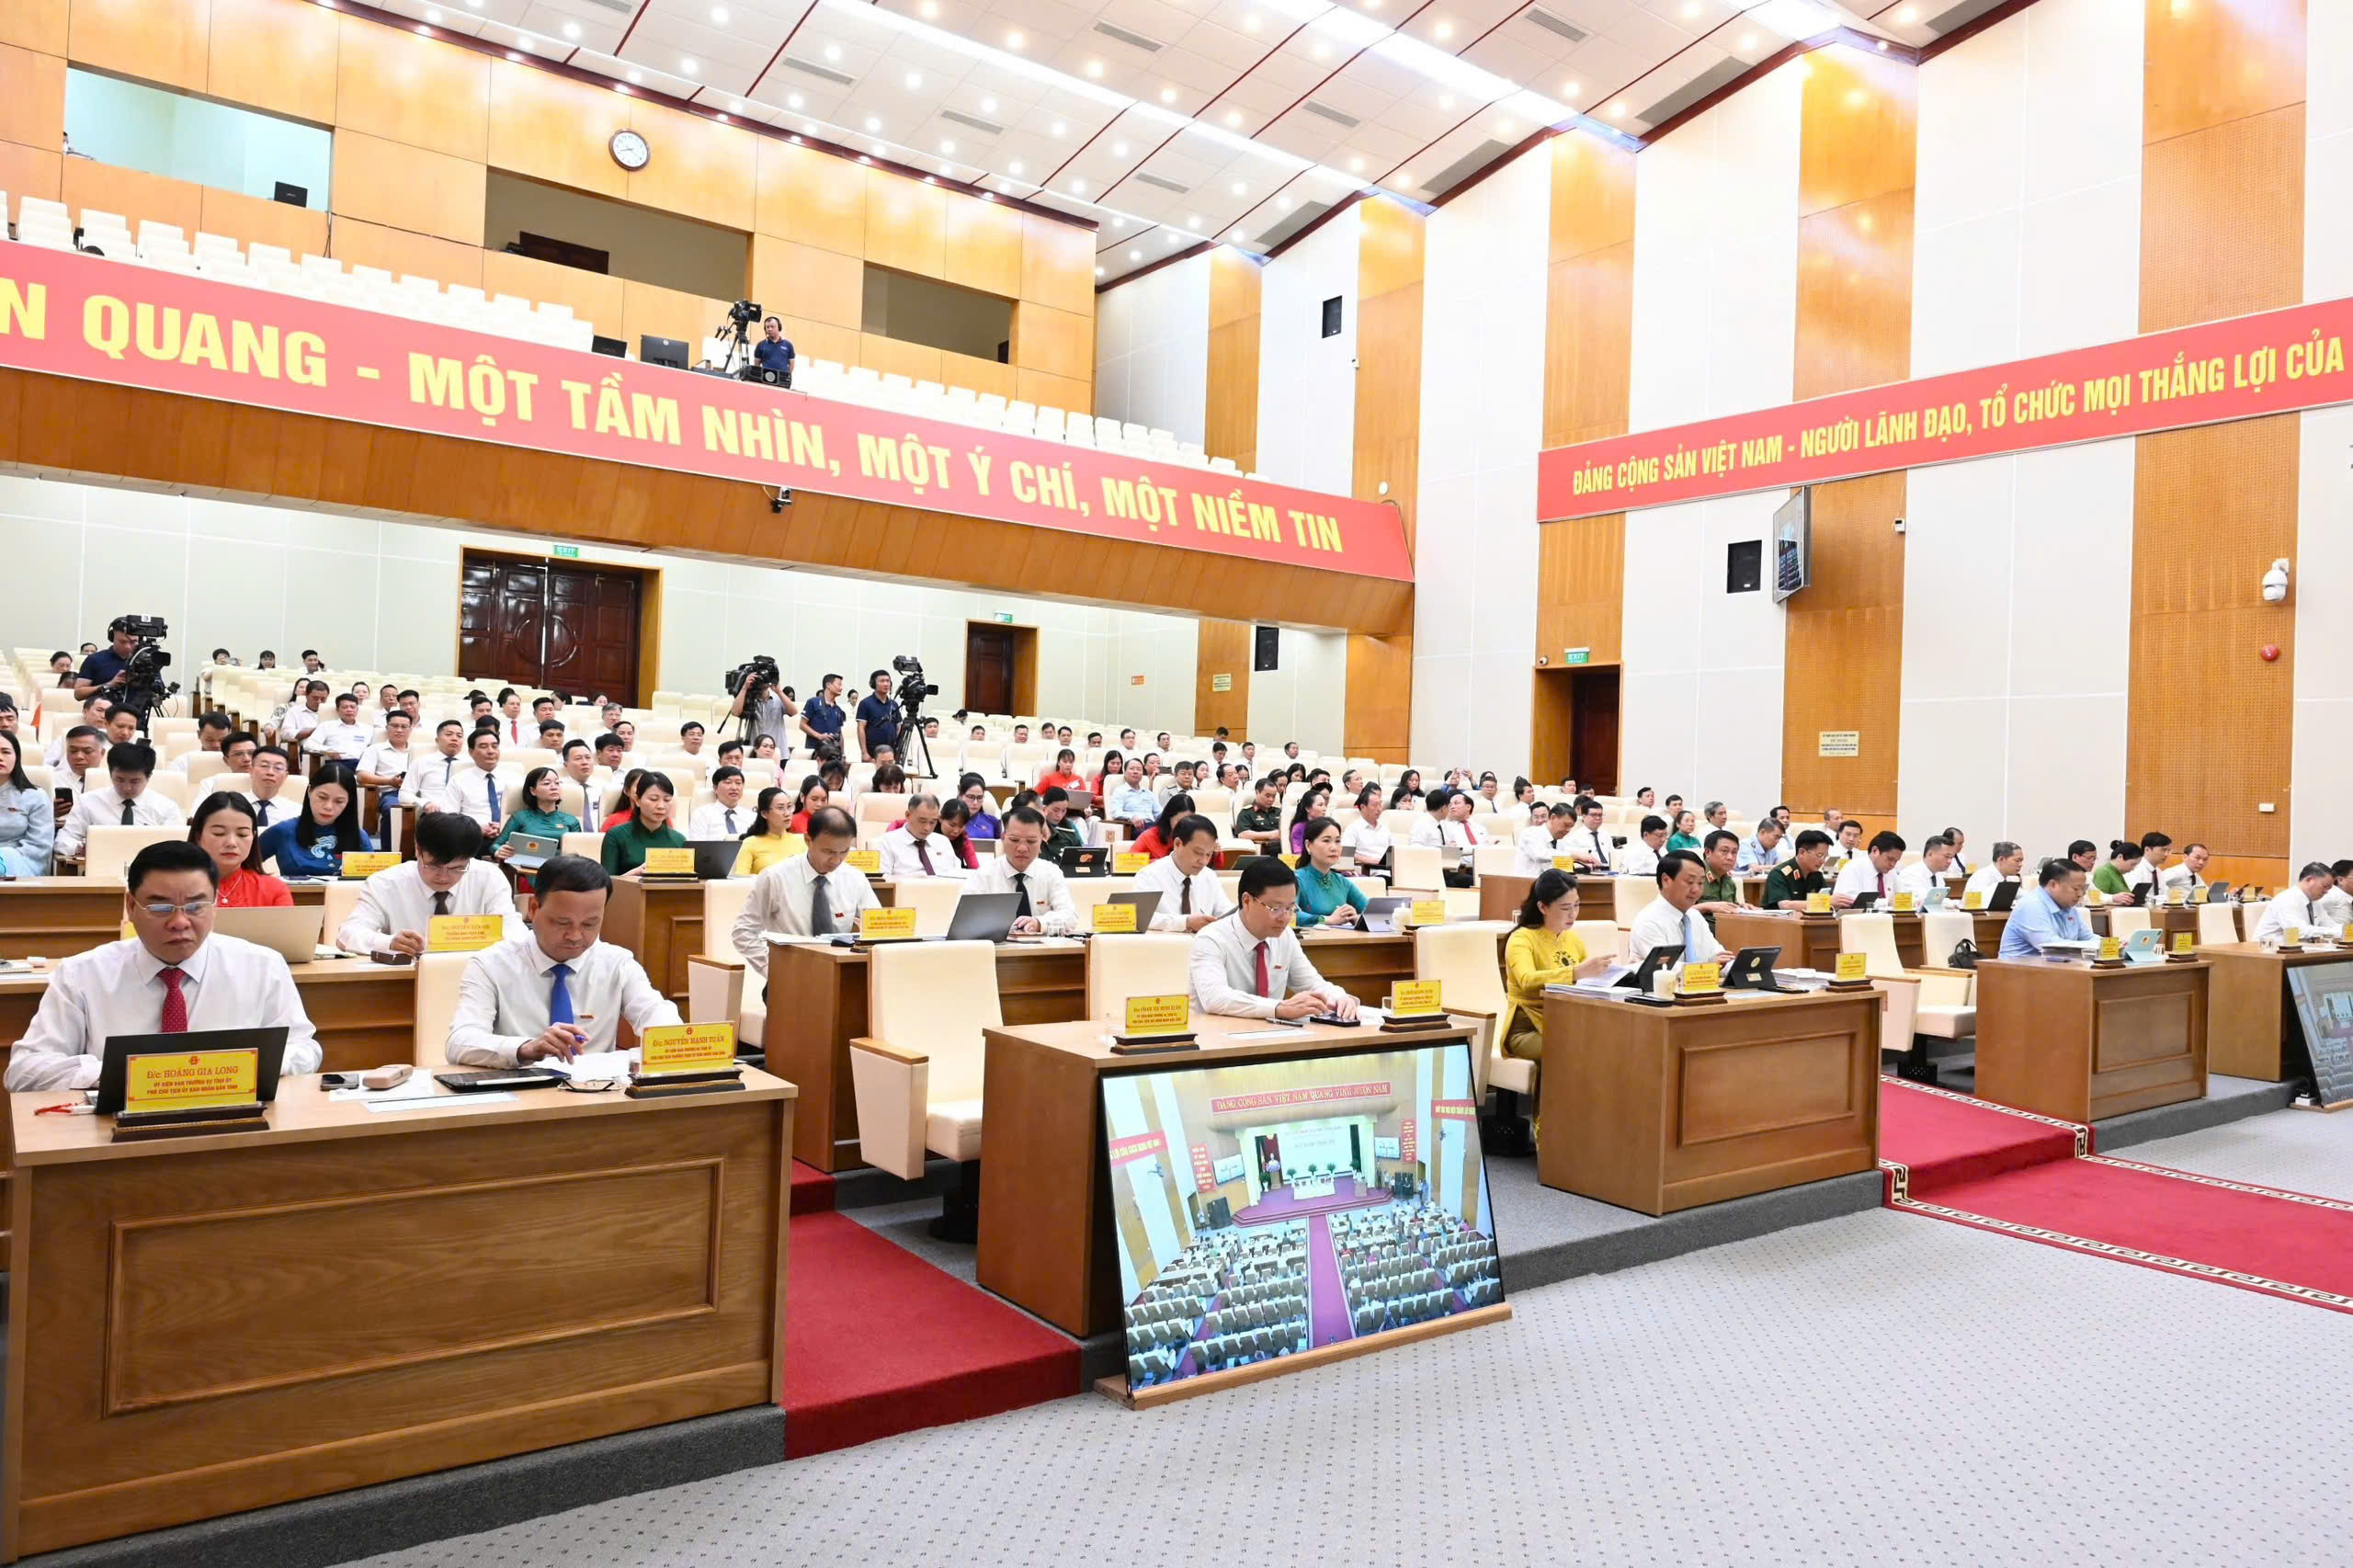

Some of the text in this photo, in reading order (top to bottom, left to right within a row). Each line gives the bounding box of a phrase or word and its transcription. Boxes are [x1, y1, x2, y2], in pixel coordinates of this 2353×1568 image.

[83, 294, 328, 388] QUANG
[356, 367, 381, 381] -
[407, 353, 540, 427] MỘT
[562, 372, 682, 447] TẦM
[702, 401, 842, 478] NHÌN,
[859, 434, 950, 498] MỘT
[970, 444, 993, 497] Ý
[1011, 461, 1092, 517] CHÍ,
[1102, 474, 1179, 528] MỘT
[1190, 483, 1282, 544] NIỀM
[1288, 510, 1344, 553] TIN
[1573, 460, 1613, 495] ĐẢNG
[1617, 454, 1660, 495] CỘNG
[1664, 441, 1698, 482] SẢN
[1700, 438, 1738, 478] VIỆT
[1741, 434, 1783, 469] NAM
[1800, 415, 1860, 459] NGƯỜI
[1864, 407, 1918, 449] LÃNH
[1923, 404, 1973, 443] ĐẠO,
[1980, 381, 2007, 429] TỔ
[2013, 379, 2076, 425] CHỨC
[2083, 375, 2131, 418] MỌI
[2139, 349, 2225, 403] THẮNG
[2234, 345, 2277, 393] LỢI
[2286, 327, 2345, 380] CỦA
[164, 1067, 195, 1078] HOÀNG
[197, 1067, 213, 1076] GIA
[214, 1065, 239, 1075] LONG
[1217, 1099, 1236, 1110] ĐẢNG
[1238, 1096, 1256, 1108] CỘNG
[1257, 1095, 1273, 1105] SẢN
[1274, 1093, 1291, 1104] VIỆT
[1292, 1092, 1309, 1102] NAM
[1311, 1089, 1335, 1102] QUANG
[1336, 1087, 1353, 1097] VINH
[1373, 1083, 1389, 1094] NAM
